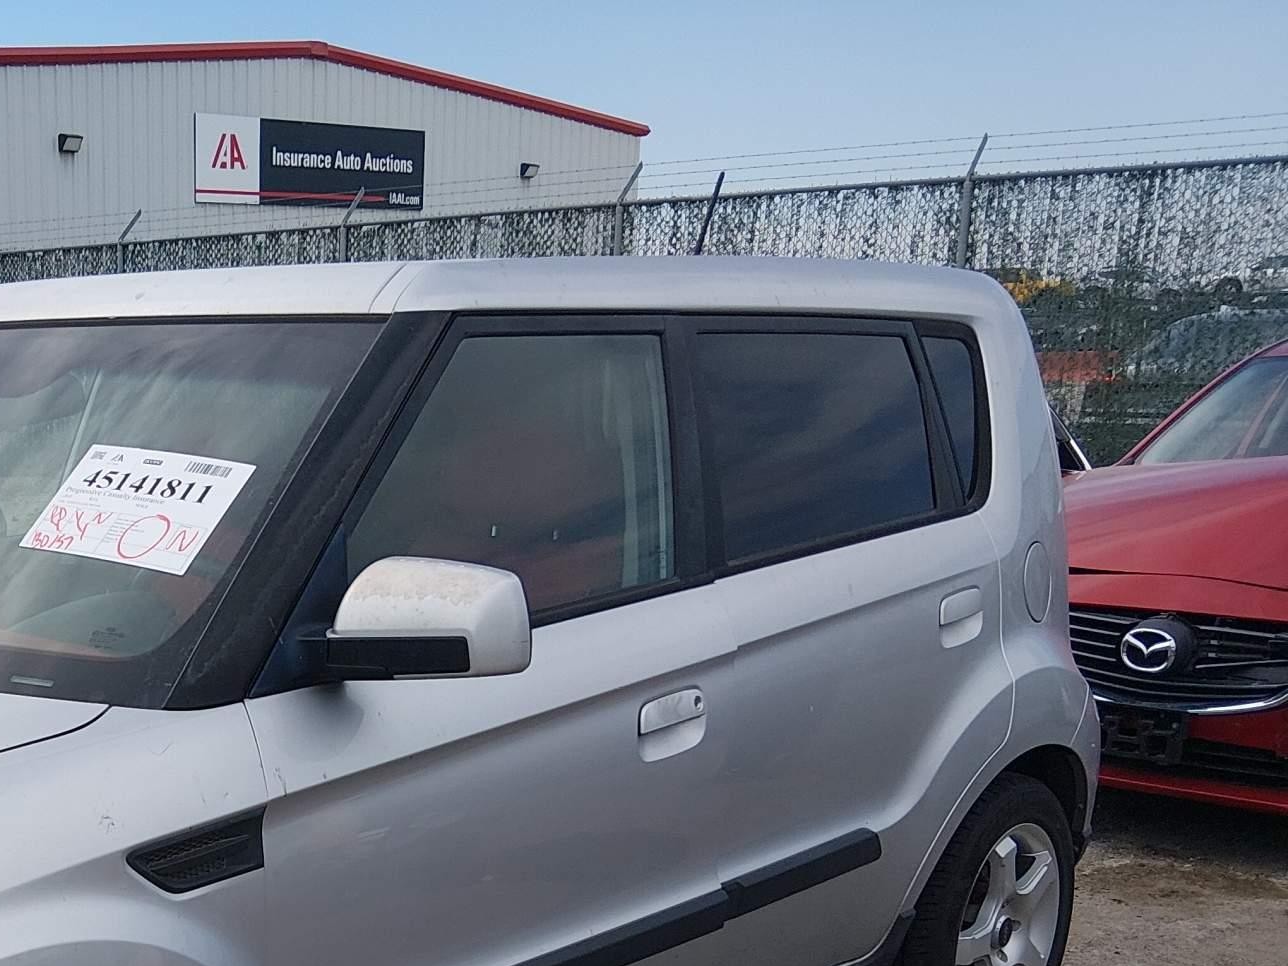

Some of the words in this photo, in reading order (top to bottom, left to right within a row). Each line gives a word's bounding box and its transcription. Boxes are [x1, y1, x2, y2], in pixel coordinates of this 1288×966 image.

[272, 146, 332, 169] Insurance
[334, 150, 361, 171] Auto
[363, 152, 413, 174] Auctions
[389, 192, 420, 206] IAAI.com
[82, 469, 214, 504] 45141811
